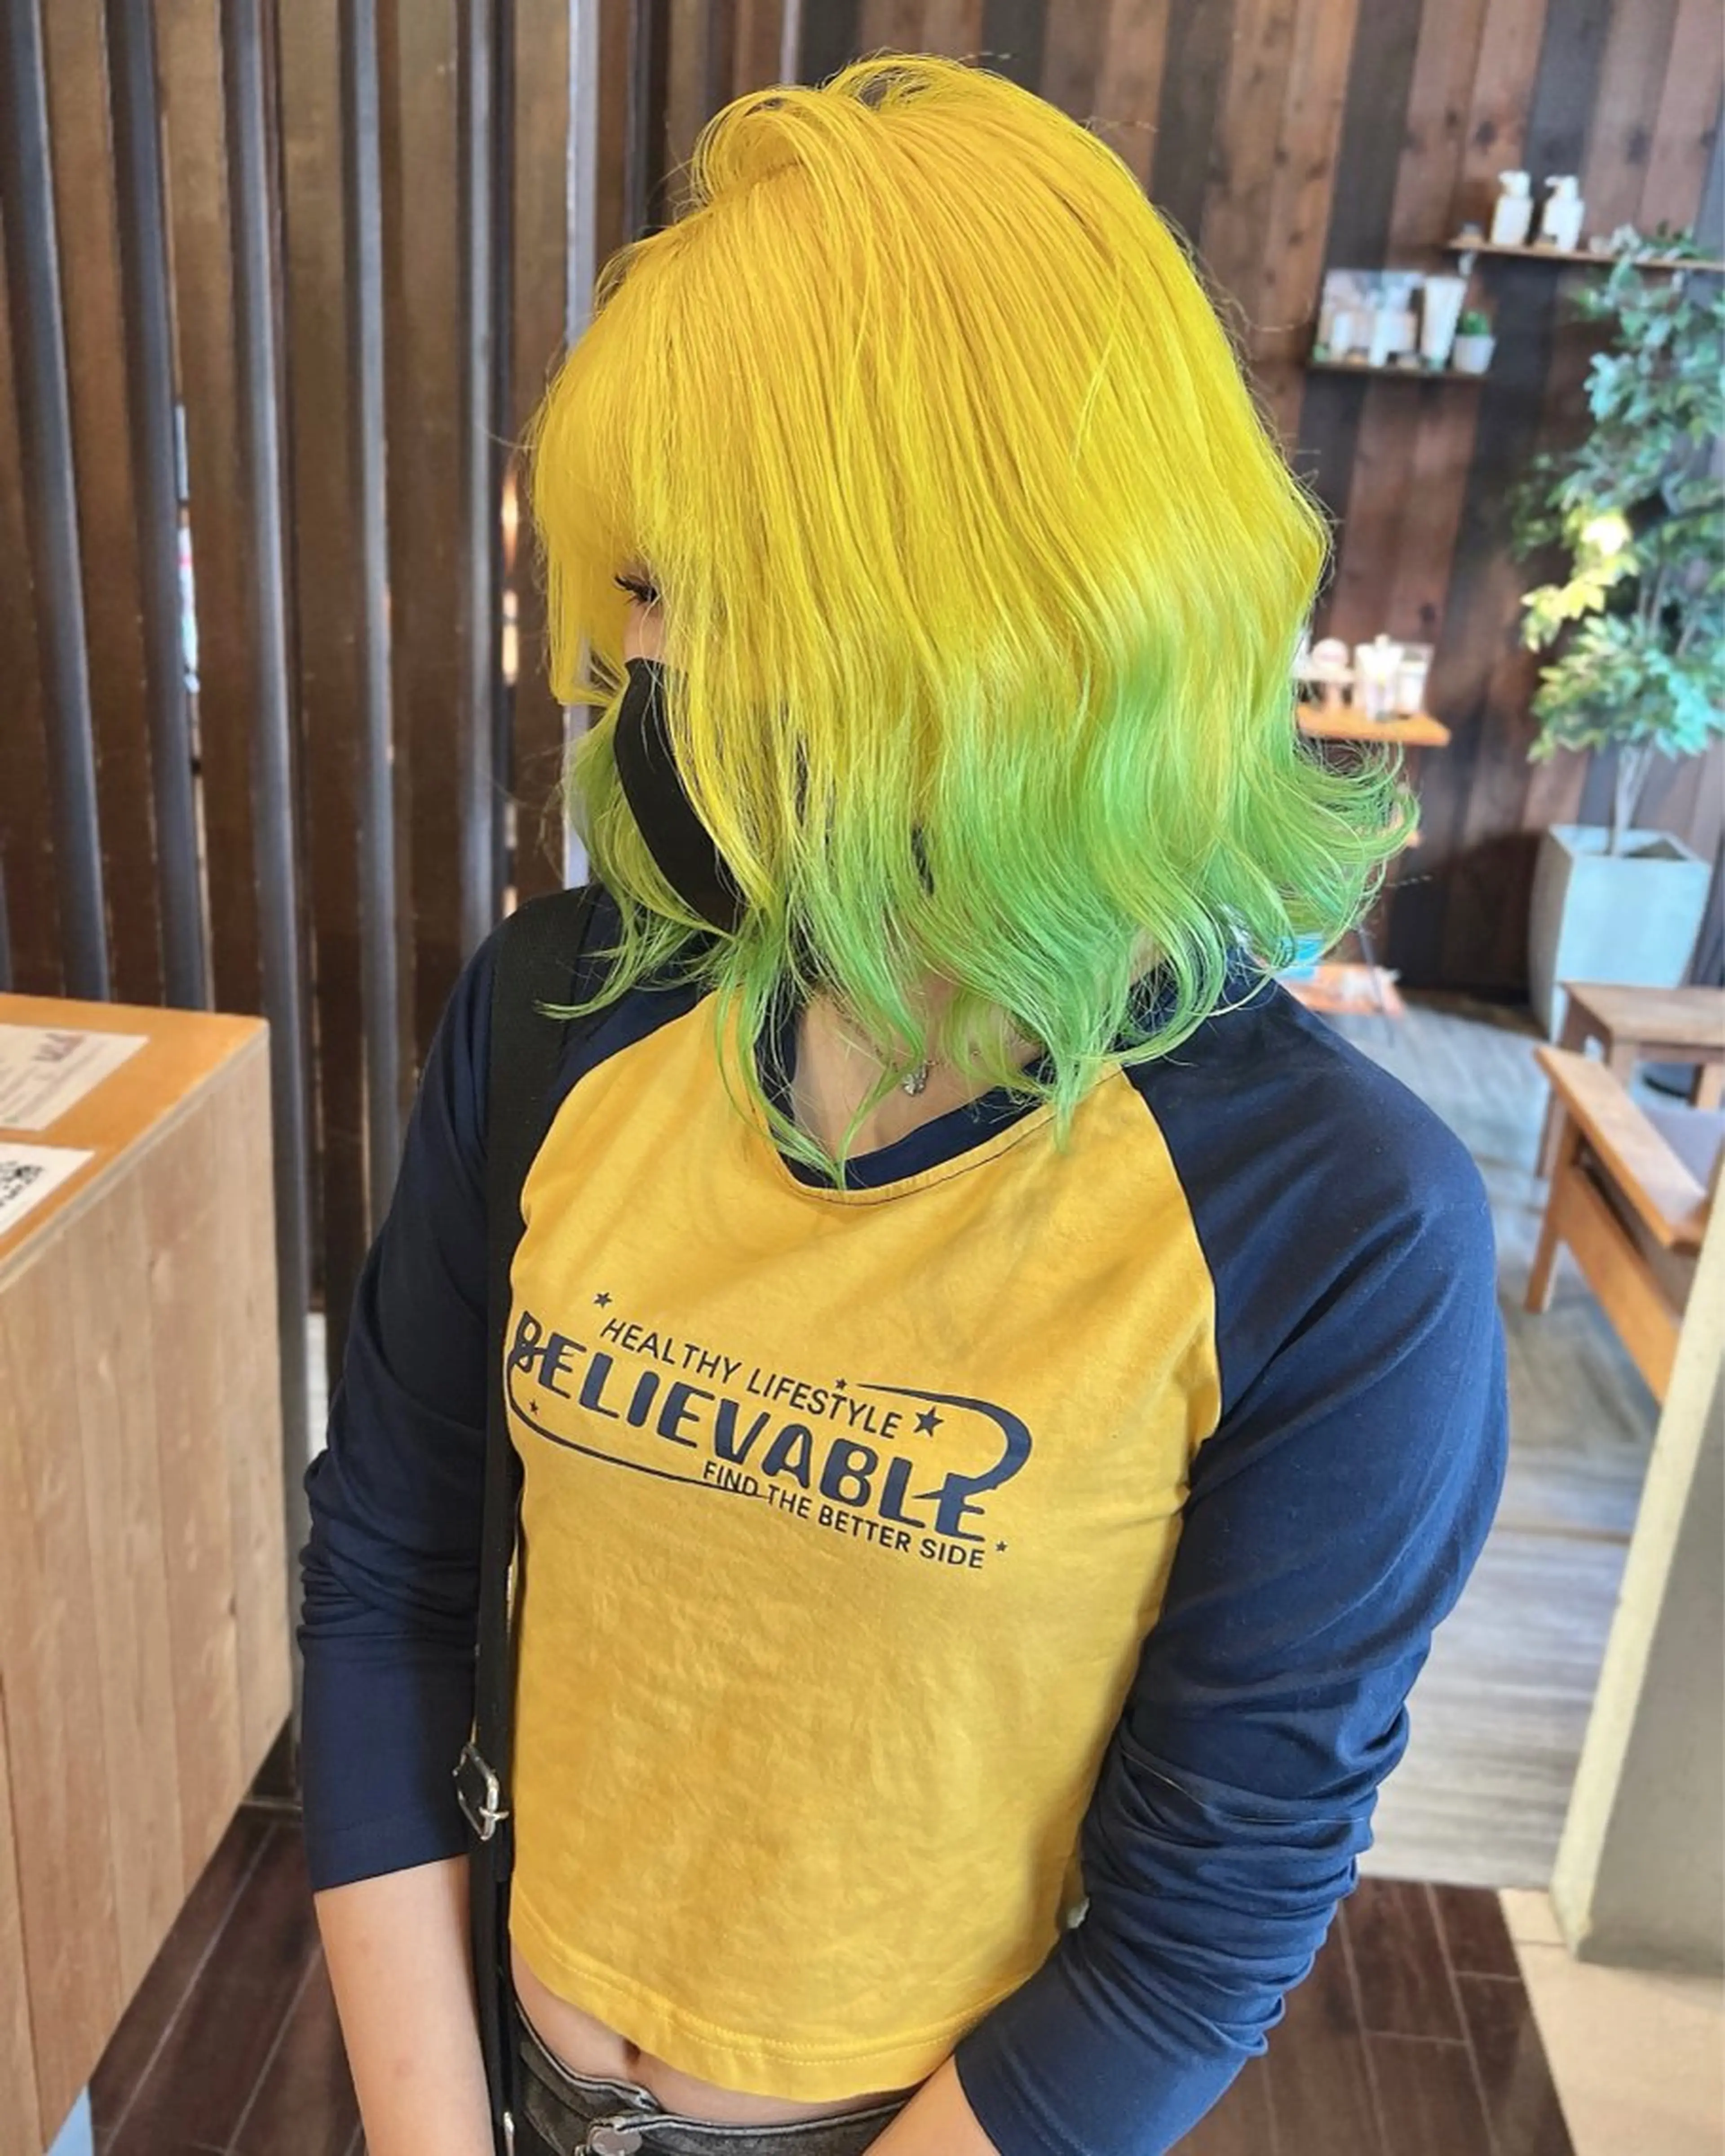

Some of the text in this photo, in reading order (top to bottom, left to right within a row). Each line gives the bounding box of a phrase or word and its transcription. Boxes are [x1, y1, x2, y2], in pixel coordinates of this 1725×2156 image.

[509, 1311, 985, 1542] BELIEVABLE
[600, 1318, 902, 1439] HEALTHY LIFESTYLE
[703, 1461, 985, 1569] FIND THE BETTER SIDE
